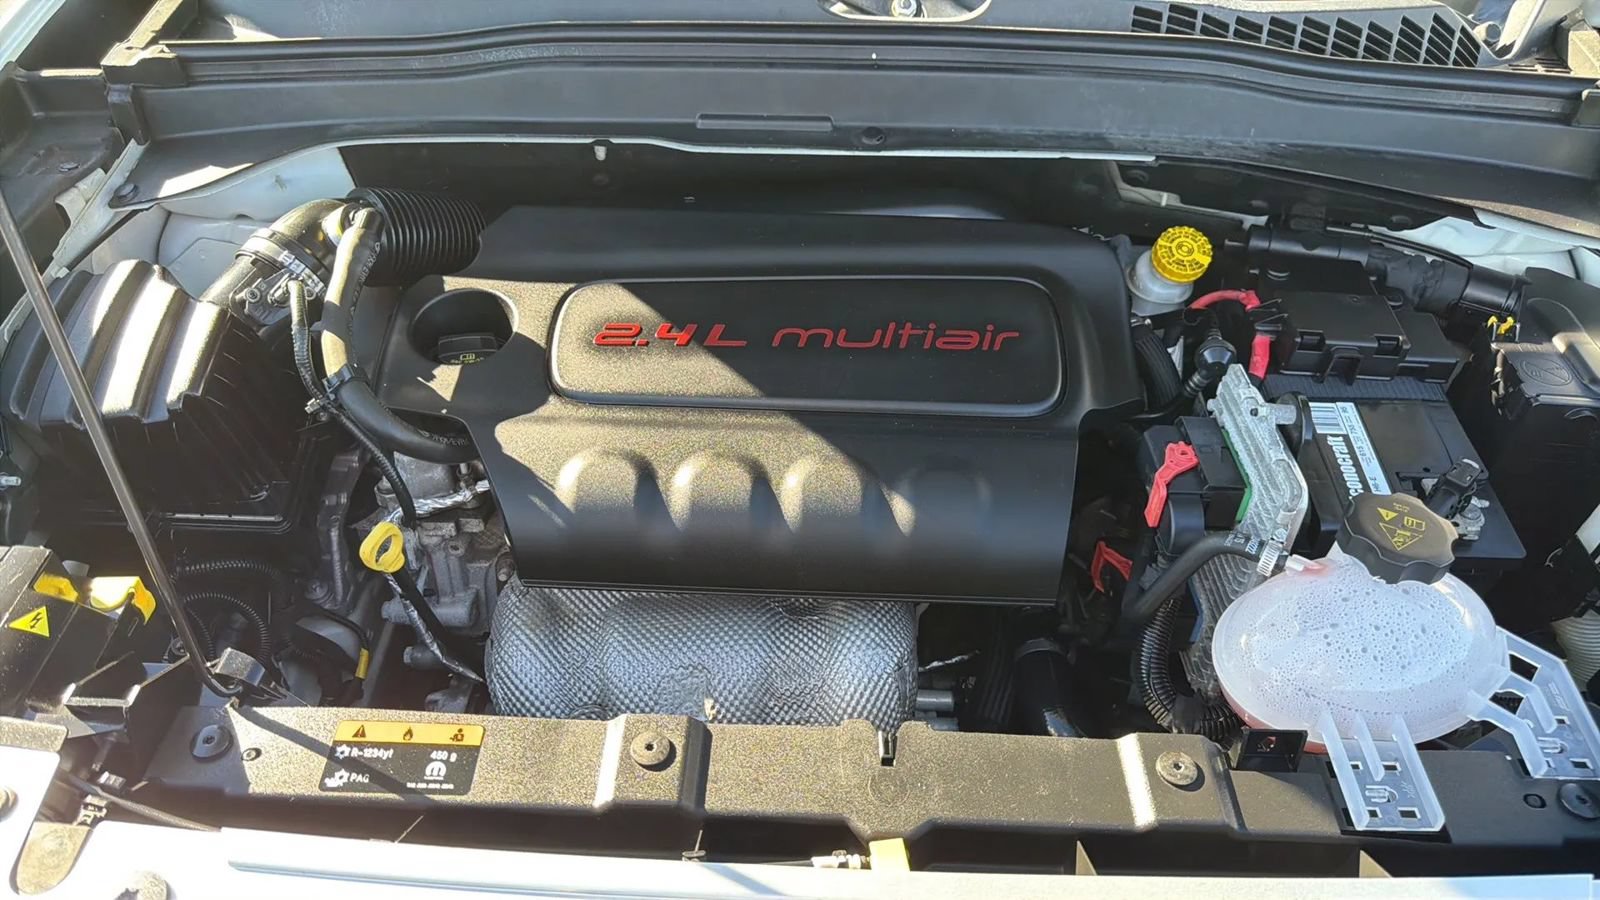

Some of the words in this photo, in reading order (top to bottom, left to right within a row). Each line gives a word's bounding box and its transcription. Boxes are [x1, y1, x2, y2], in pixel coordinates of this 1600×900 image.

[771, 322, 1020, 351] multiair
[1327, 435, 1364, 500] conocraft
[350, 748, 394, 761] R-1234yf
[349, 772, 369, 783] PAG
